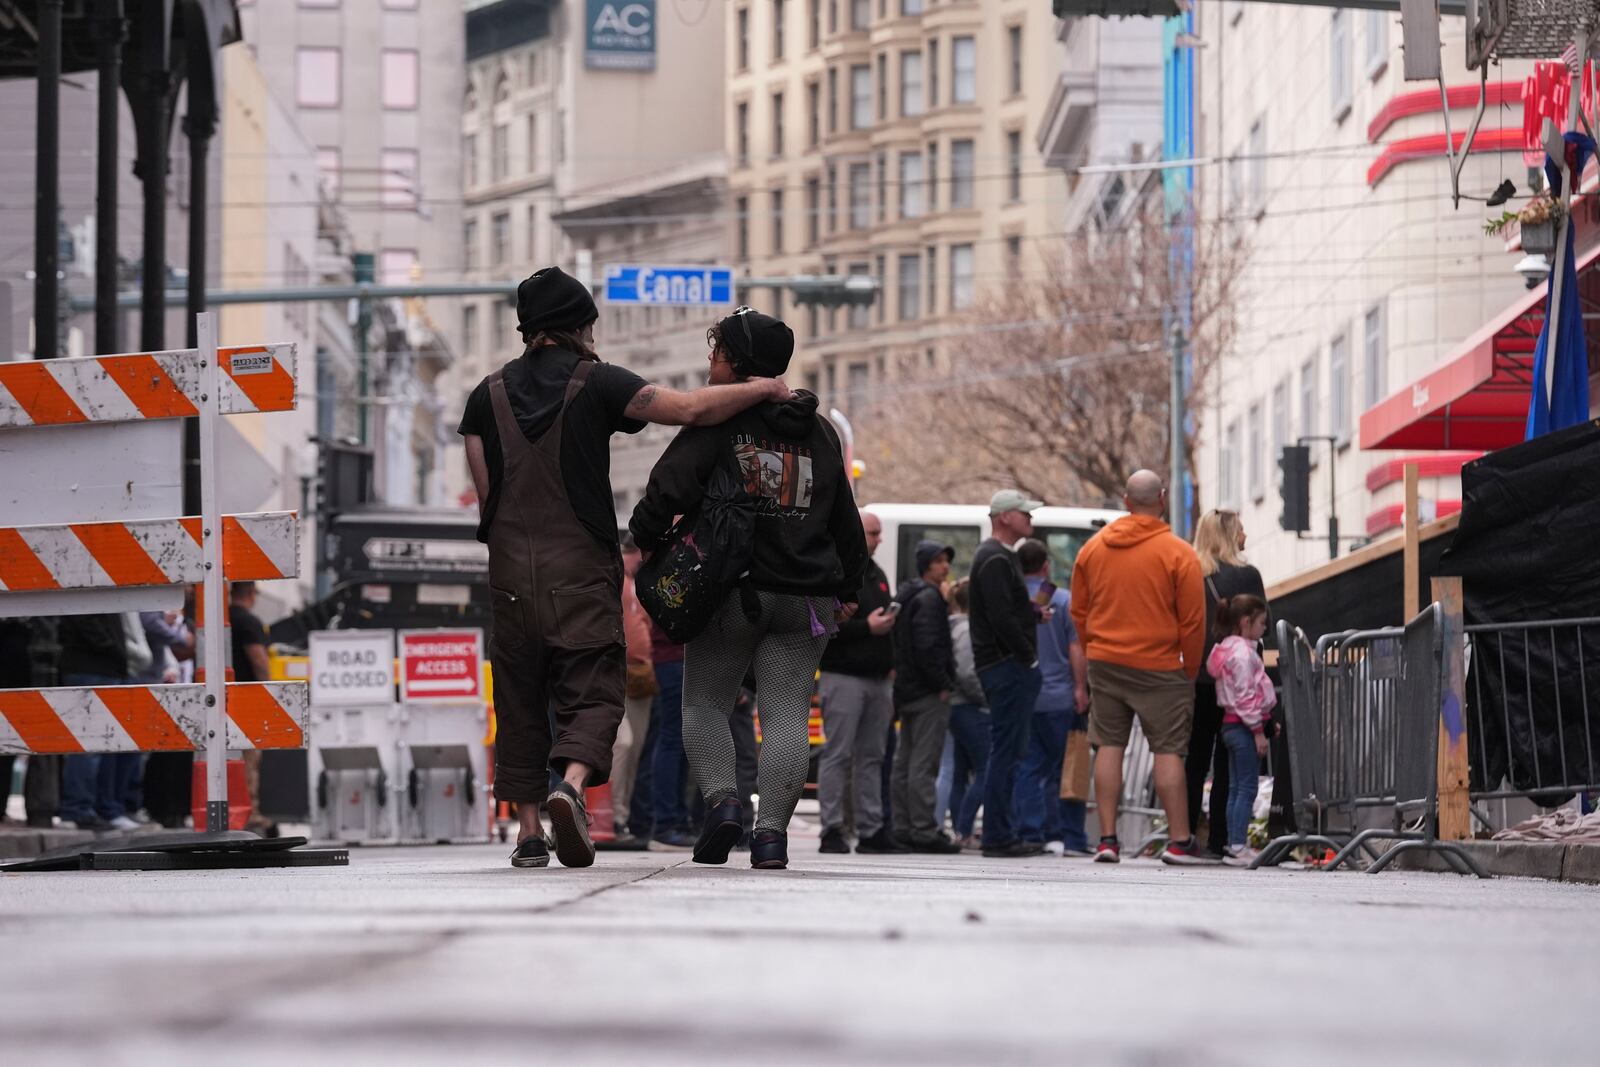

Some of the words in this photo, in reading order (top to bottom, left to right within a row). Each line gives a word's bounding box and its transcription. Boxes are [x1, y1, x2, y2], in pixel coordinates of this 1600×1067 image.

[592, 3, 651, 35] AC
[637, 267, 711, 302] Canal
[405, 642, 478, 657] EMERGENCY
[327, 651, 376, 666] ROAD
[416, 660, 467, 675] ACCESS
[318, 671, 387, 688] CLOSED
